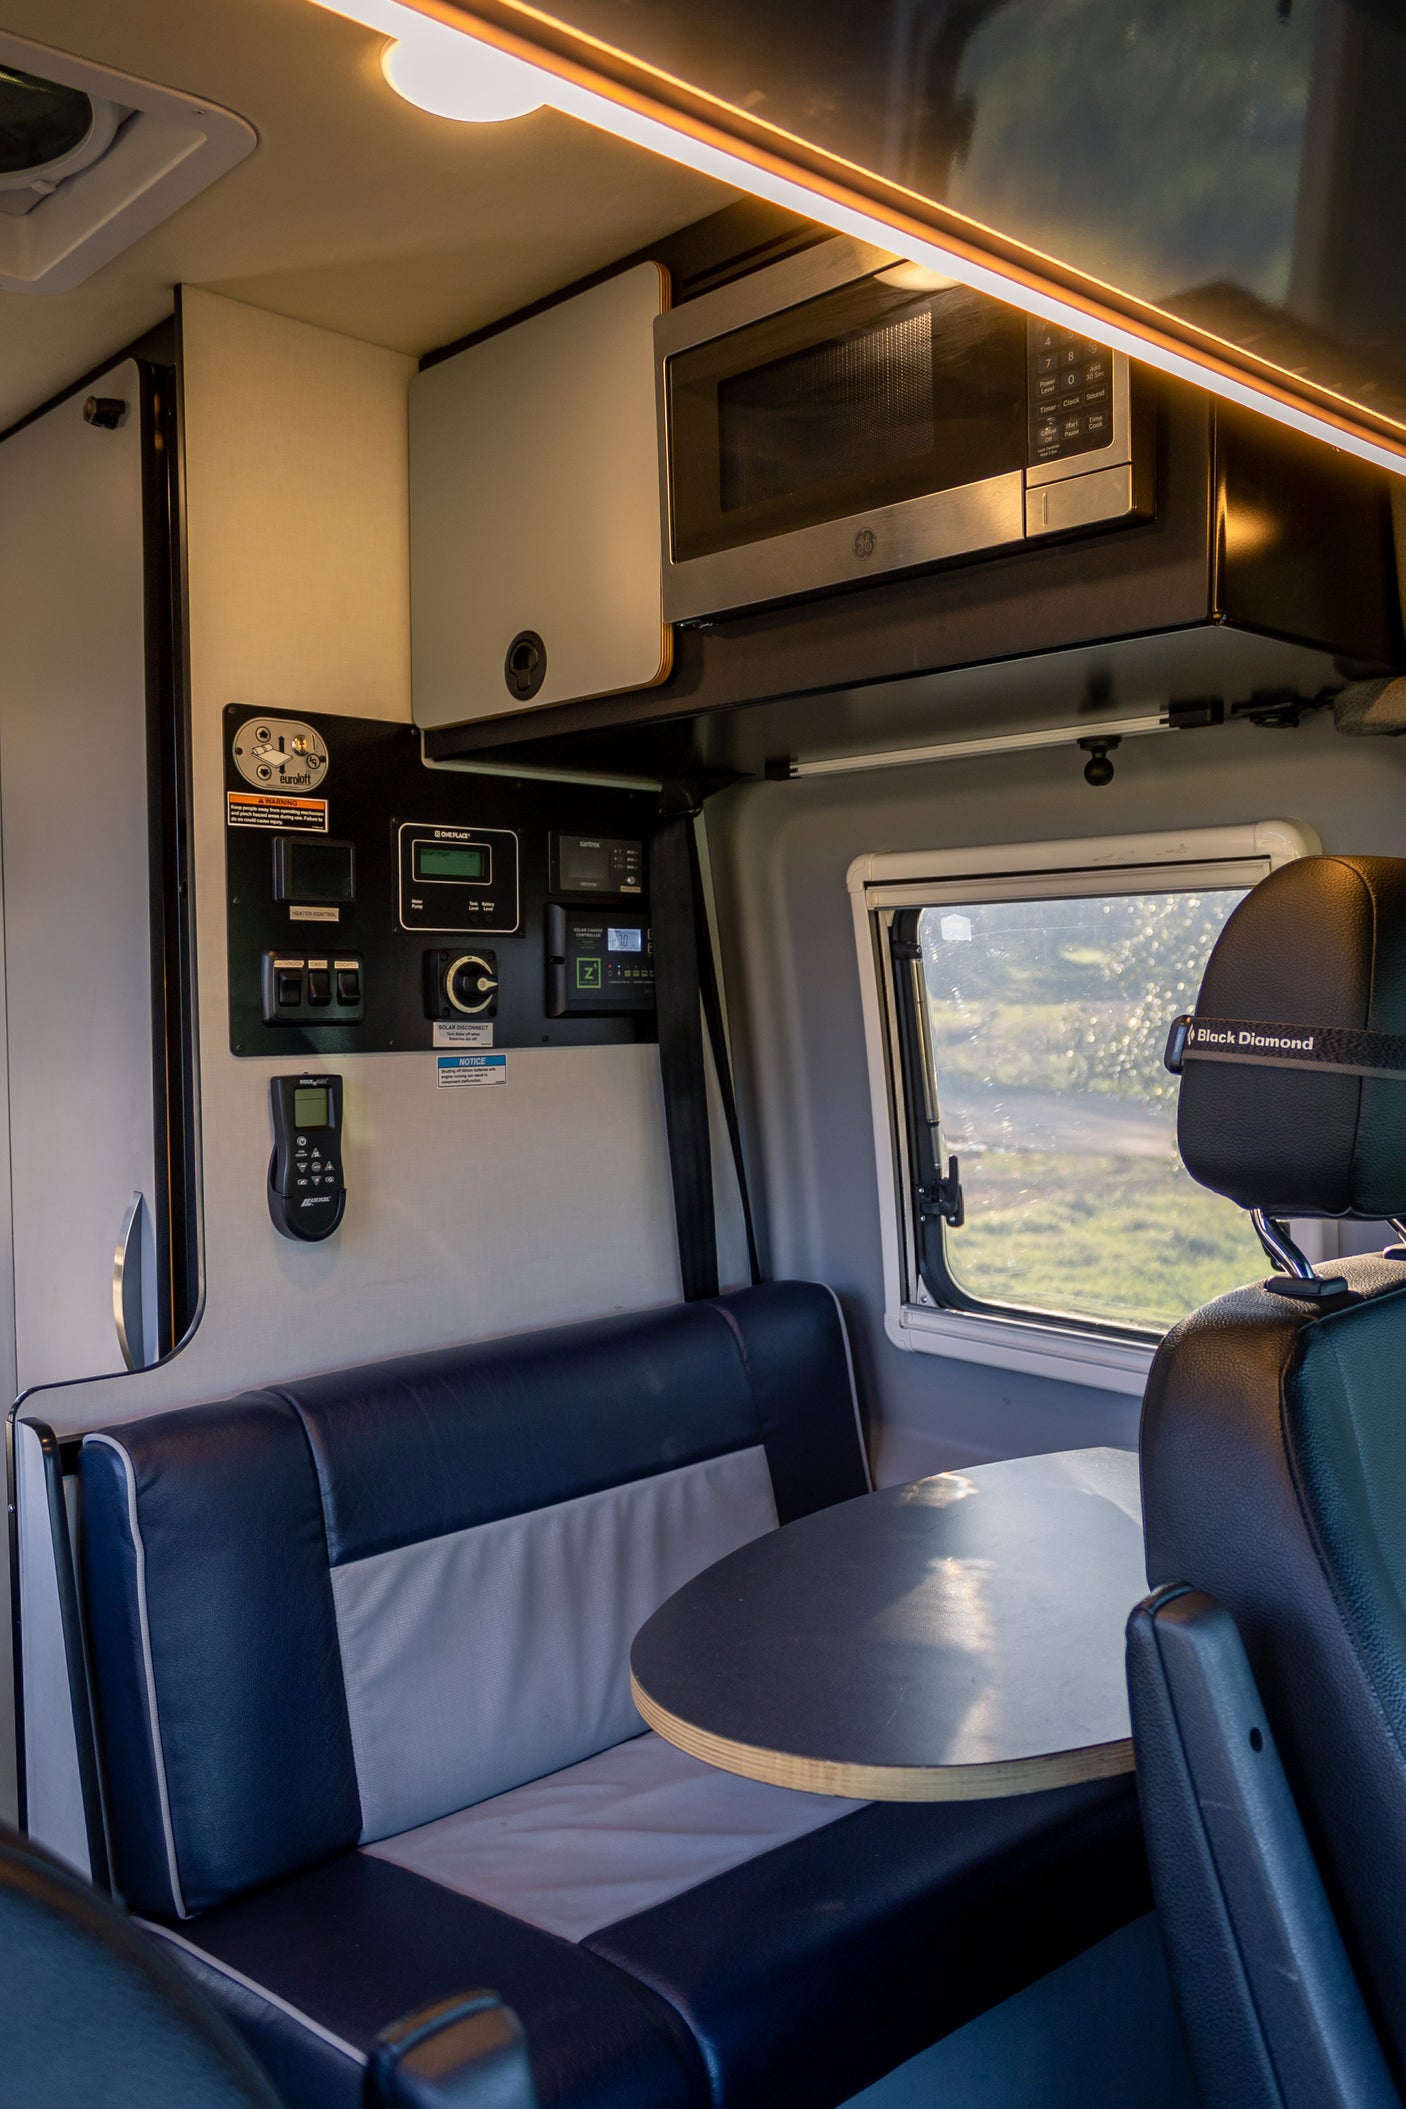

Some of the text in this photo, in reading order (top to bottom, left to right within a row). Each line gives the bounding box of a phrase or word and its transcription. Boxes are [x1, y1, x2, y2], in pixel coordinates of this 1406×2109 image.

[1045, 336, 1051, 346] 4
[1067, 351, 1074, 361] 8
[1046, 358, 1051, 369] 7
[1089, 364, 1101, 372] Add
[1067, 374, 1075, 385] 0
[1085, 370, 1105, 381] 30 Sec
[1040, 378, 1056, 388] Power
[1041, 386, 1055, 395] Level
[1086, 388, 1105, 400] Sound
[1063, 397, 1080, 407] Clock
[1040, 403, 1056, 414] Timer
[1089, 415, 1103, 423] Time
[1088, 421, 1103, 430] Cook
[1064, 429, 1079, 438] Pause
[280, 773, 311, 785] euroloft
[265, 797, 298, 806] WARNING
[1197, 1028, 1314, 1051] Black Diamond
[459, 1057, 486, 1065] NOTICE
